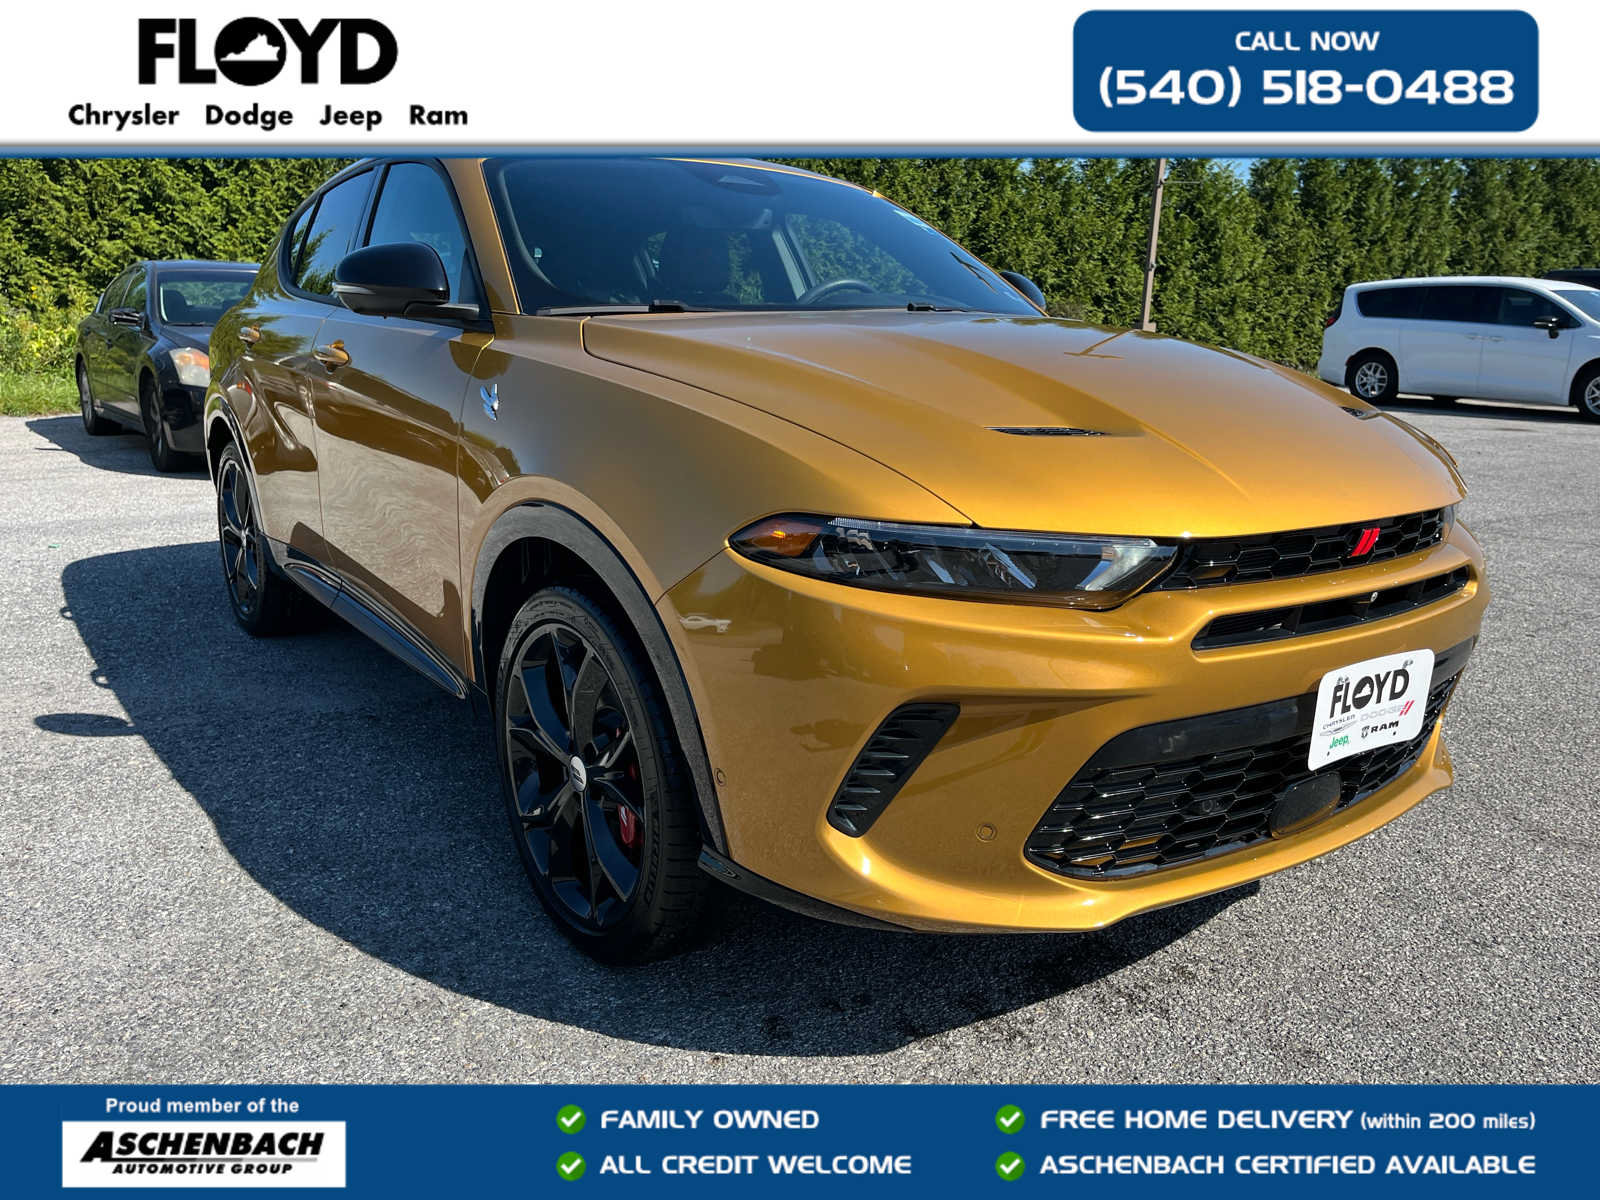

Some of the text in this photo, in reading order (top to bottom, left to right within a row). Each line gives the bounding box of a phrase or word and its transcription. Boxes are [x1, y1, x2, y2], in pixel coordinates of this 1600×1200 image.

[1329, 668, 1409, 719] FLOYD
[1322, 714, 1356, 729] CHRYSLER
[1370, 720, 1399, 734] RAM
[1329, 735, 1349, 749] Jeep
